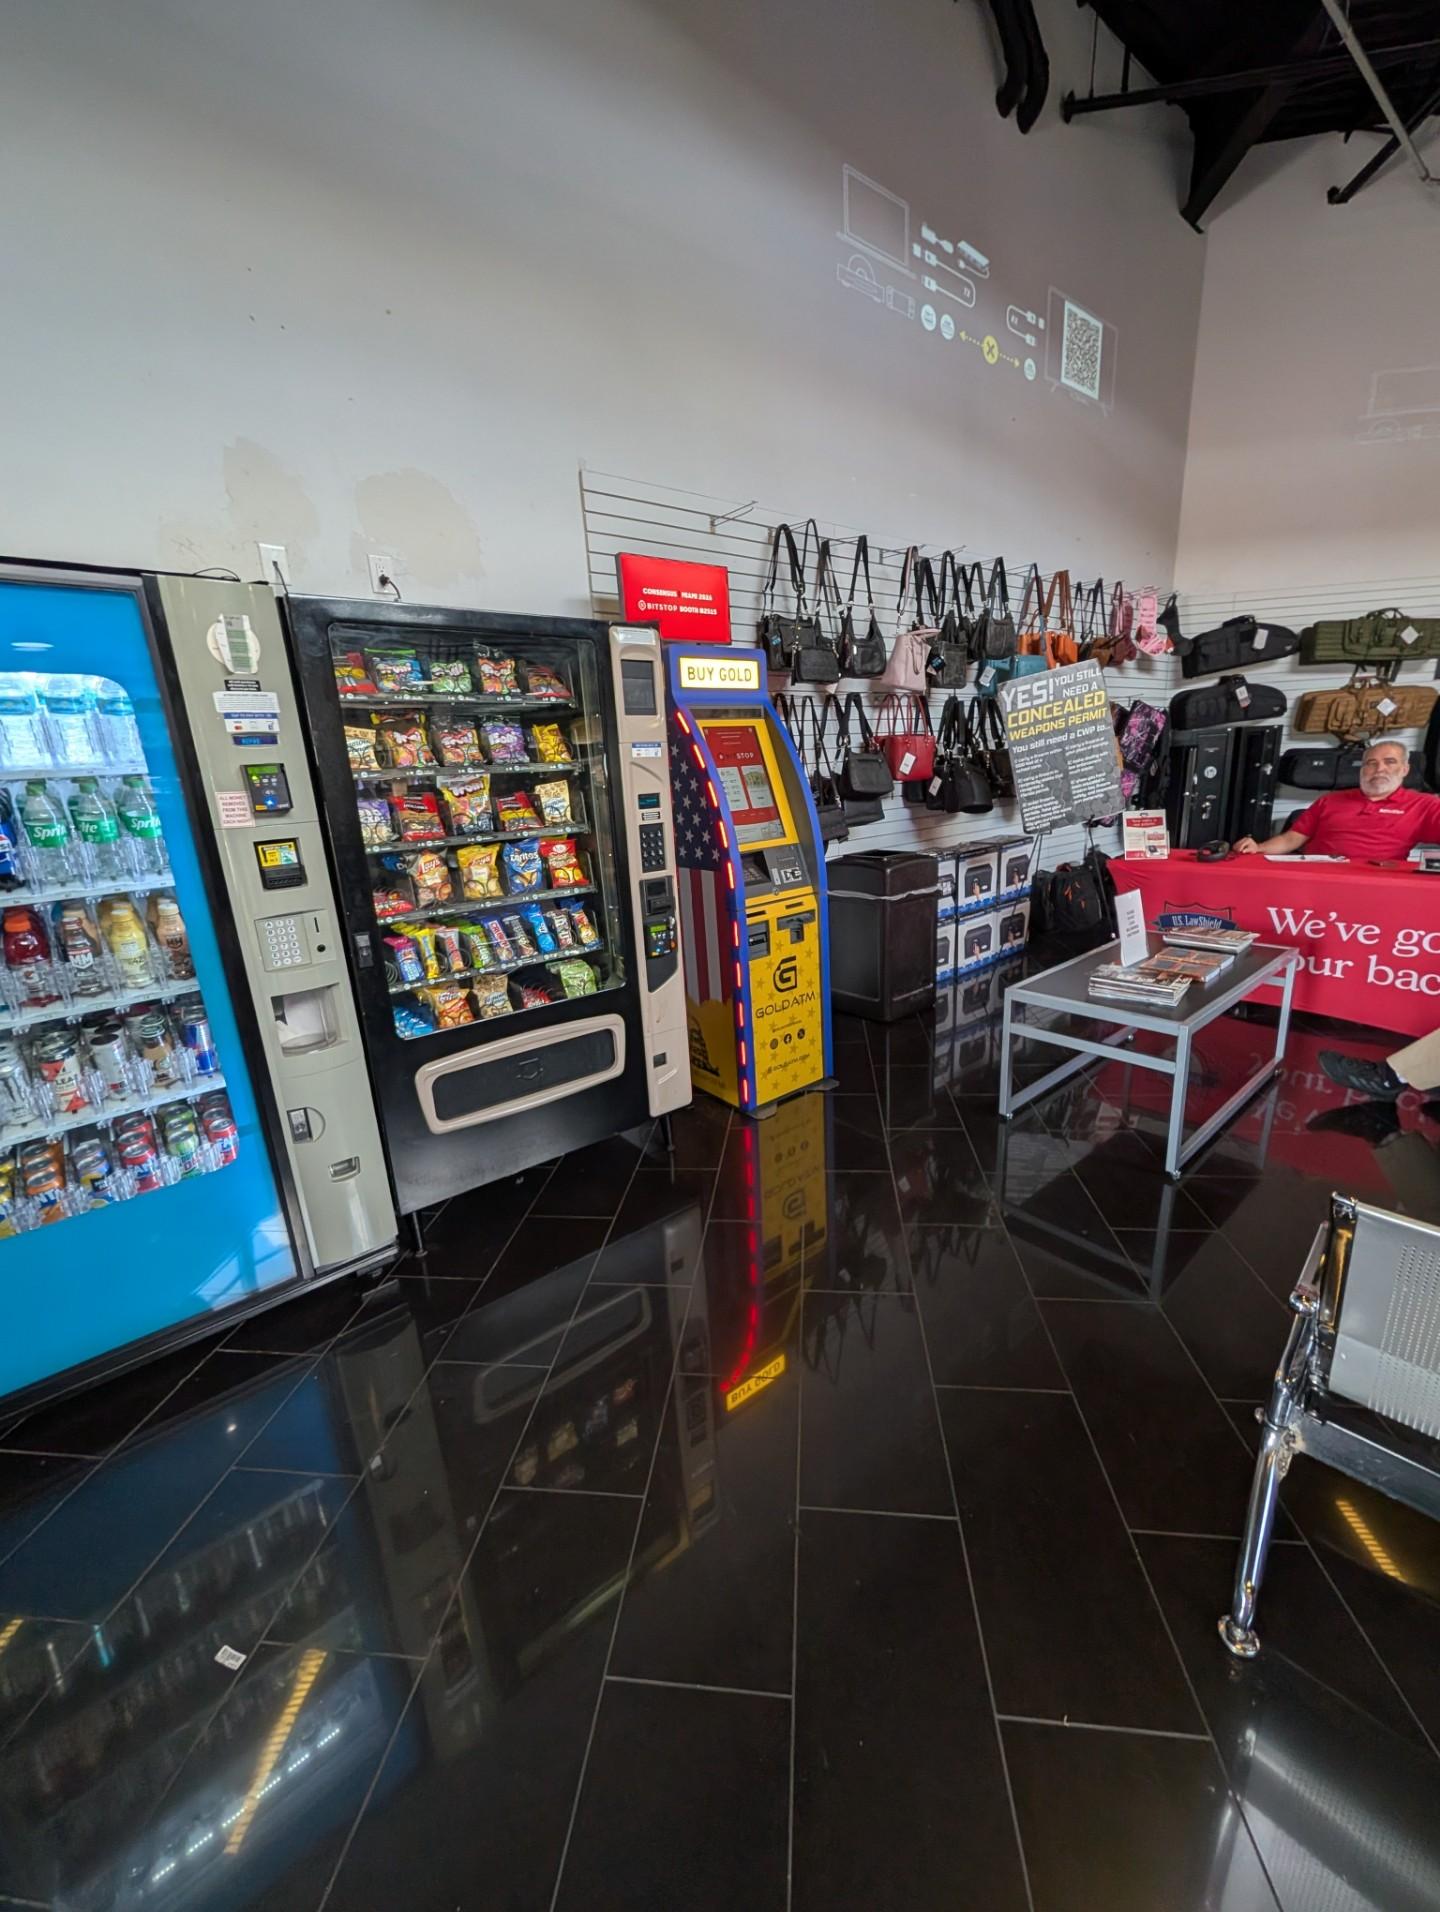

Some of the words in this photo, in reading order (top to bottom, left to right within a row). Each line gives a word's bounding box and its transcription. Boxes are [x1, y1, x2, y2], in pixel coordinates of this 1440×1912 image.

[642, 587, 678, 598] CONSENSUS
[646, 602, 678, 612] BITSTOP
[679, 605, 699, 614] BOOTH
[687, 665, 714, 682] BUY
[719, 667, 752, 683] GOLD
[1001, 678, 1054, 713] YES!
[1054, 673, 1075, 686] YOU
[1076, 667, 1102, 681] STILL
[1062, 684, 1088, 698] NEED
[1091, 681, 1098, 691] A
[1007, 690, 1106, 729] CONCEALED
[1009, 718, 1066, 742] WEAPONS
[1068, 707, 1108, 726] PERMIT
[1012, 743, 1029, 754] You
[1030, 738, 1045, 749] still
[1046, 732, 1068, 745] need
[1076, 725, 1096, 737] CWP
[421, 858, 441, 874] Lay's
[510, 851, 540, 864] Doritos
[1266, 906, 1381, 945] We've
[1295, 953, 1354, 979] our
[755, 990, 817, 1019] GOLDATM
